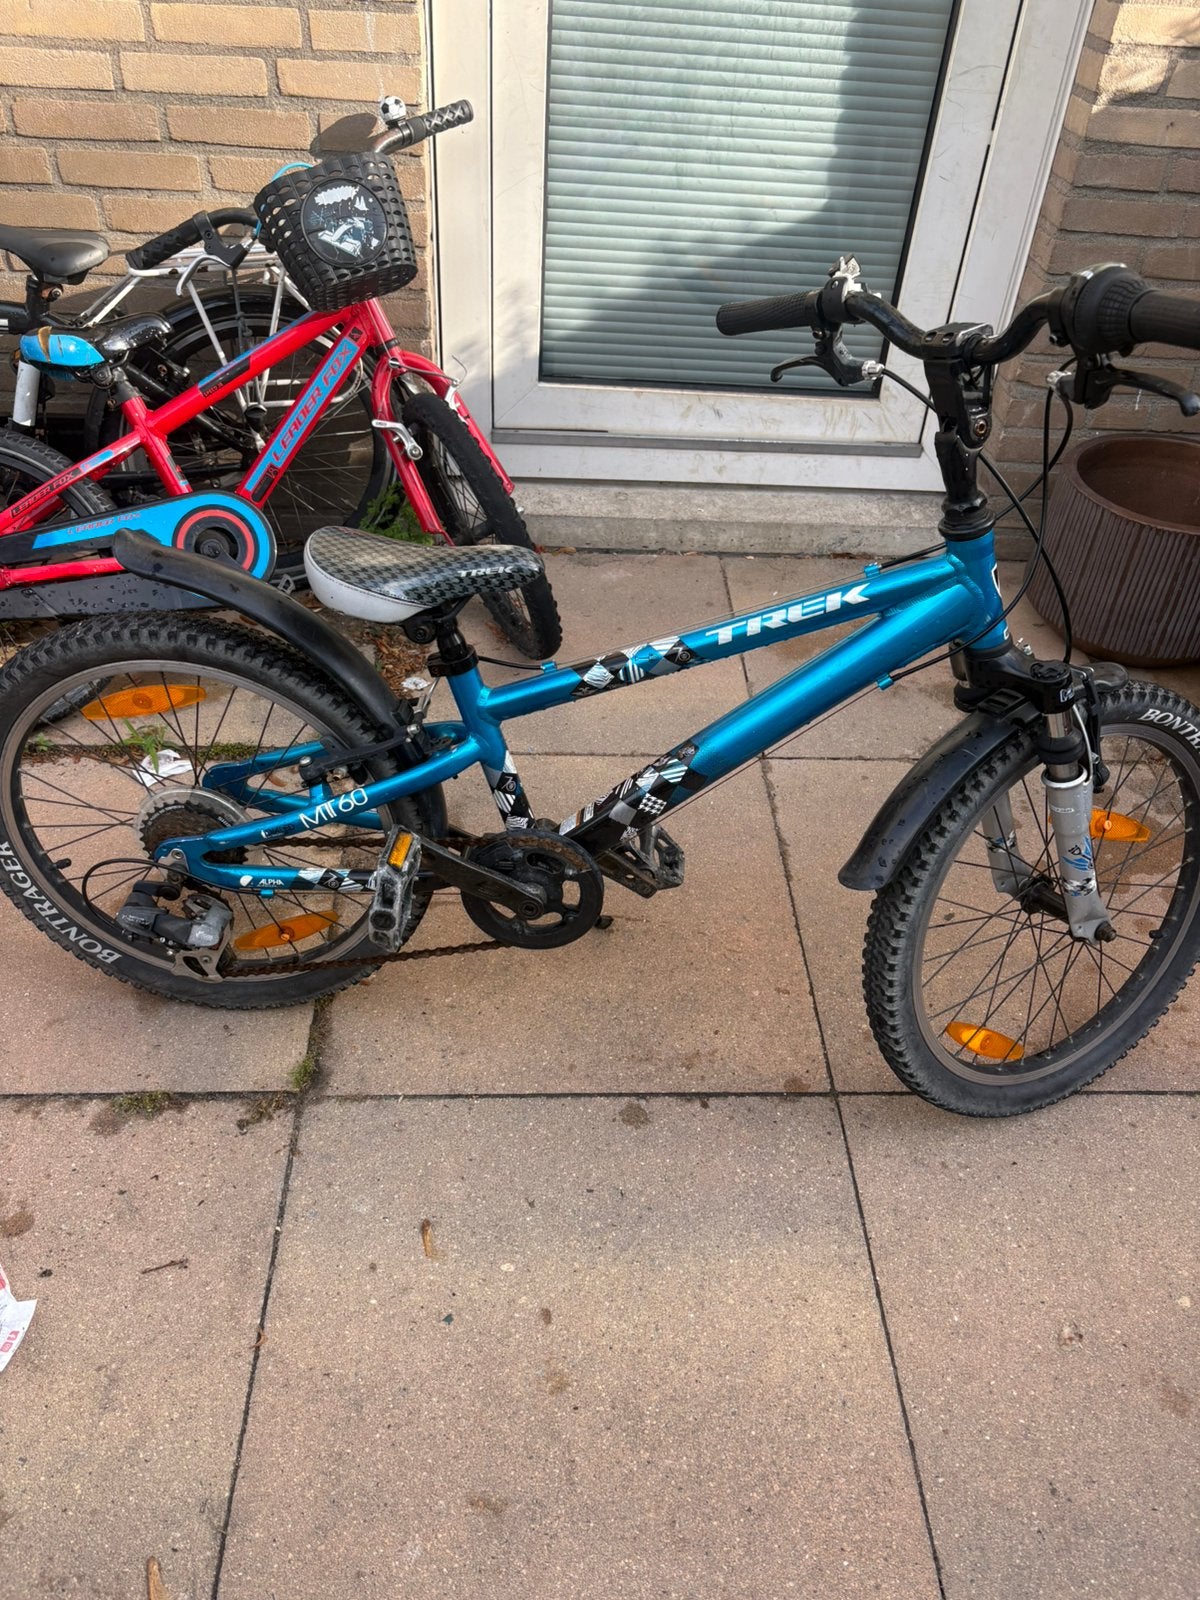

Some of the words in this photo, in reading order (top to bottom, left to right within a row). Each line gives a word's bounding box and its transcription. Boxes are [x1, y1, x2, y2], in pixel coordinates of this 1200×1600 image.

[271, 385, 322, 463] LEADER
[321, 343, 352, 387] FOX
[12, 485, 51, 516] LEADER
[53, 472, 74, 489] FOX
[457, 566, 514, 578] TREK
[705, 582, 871, 645] TREK
[1137, 708, 1200, 754] BONTR
[0, 841, 122, 964] BONTRAGER
[259, 878, 285, 886] ALPHA
